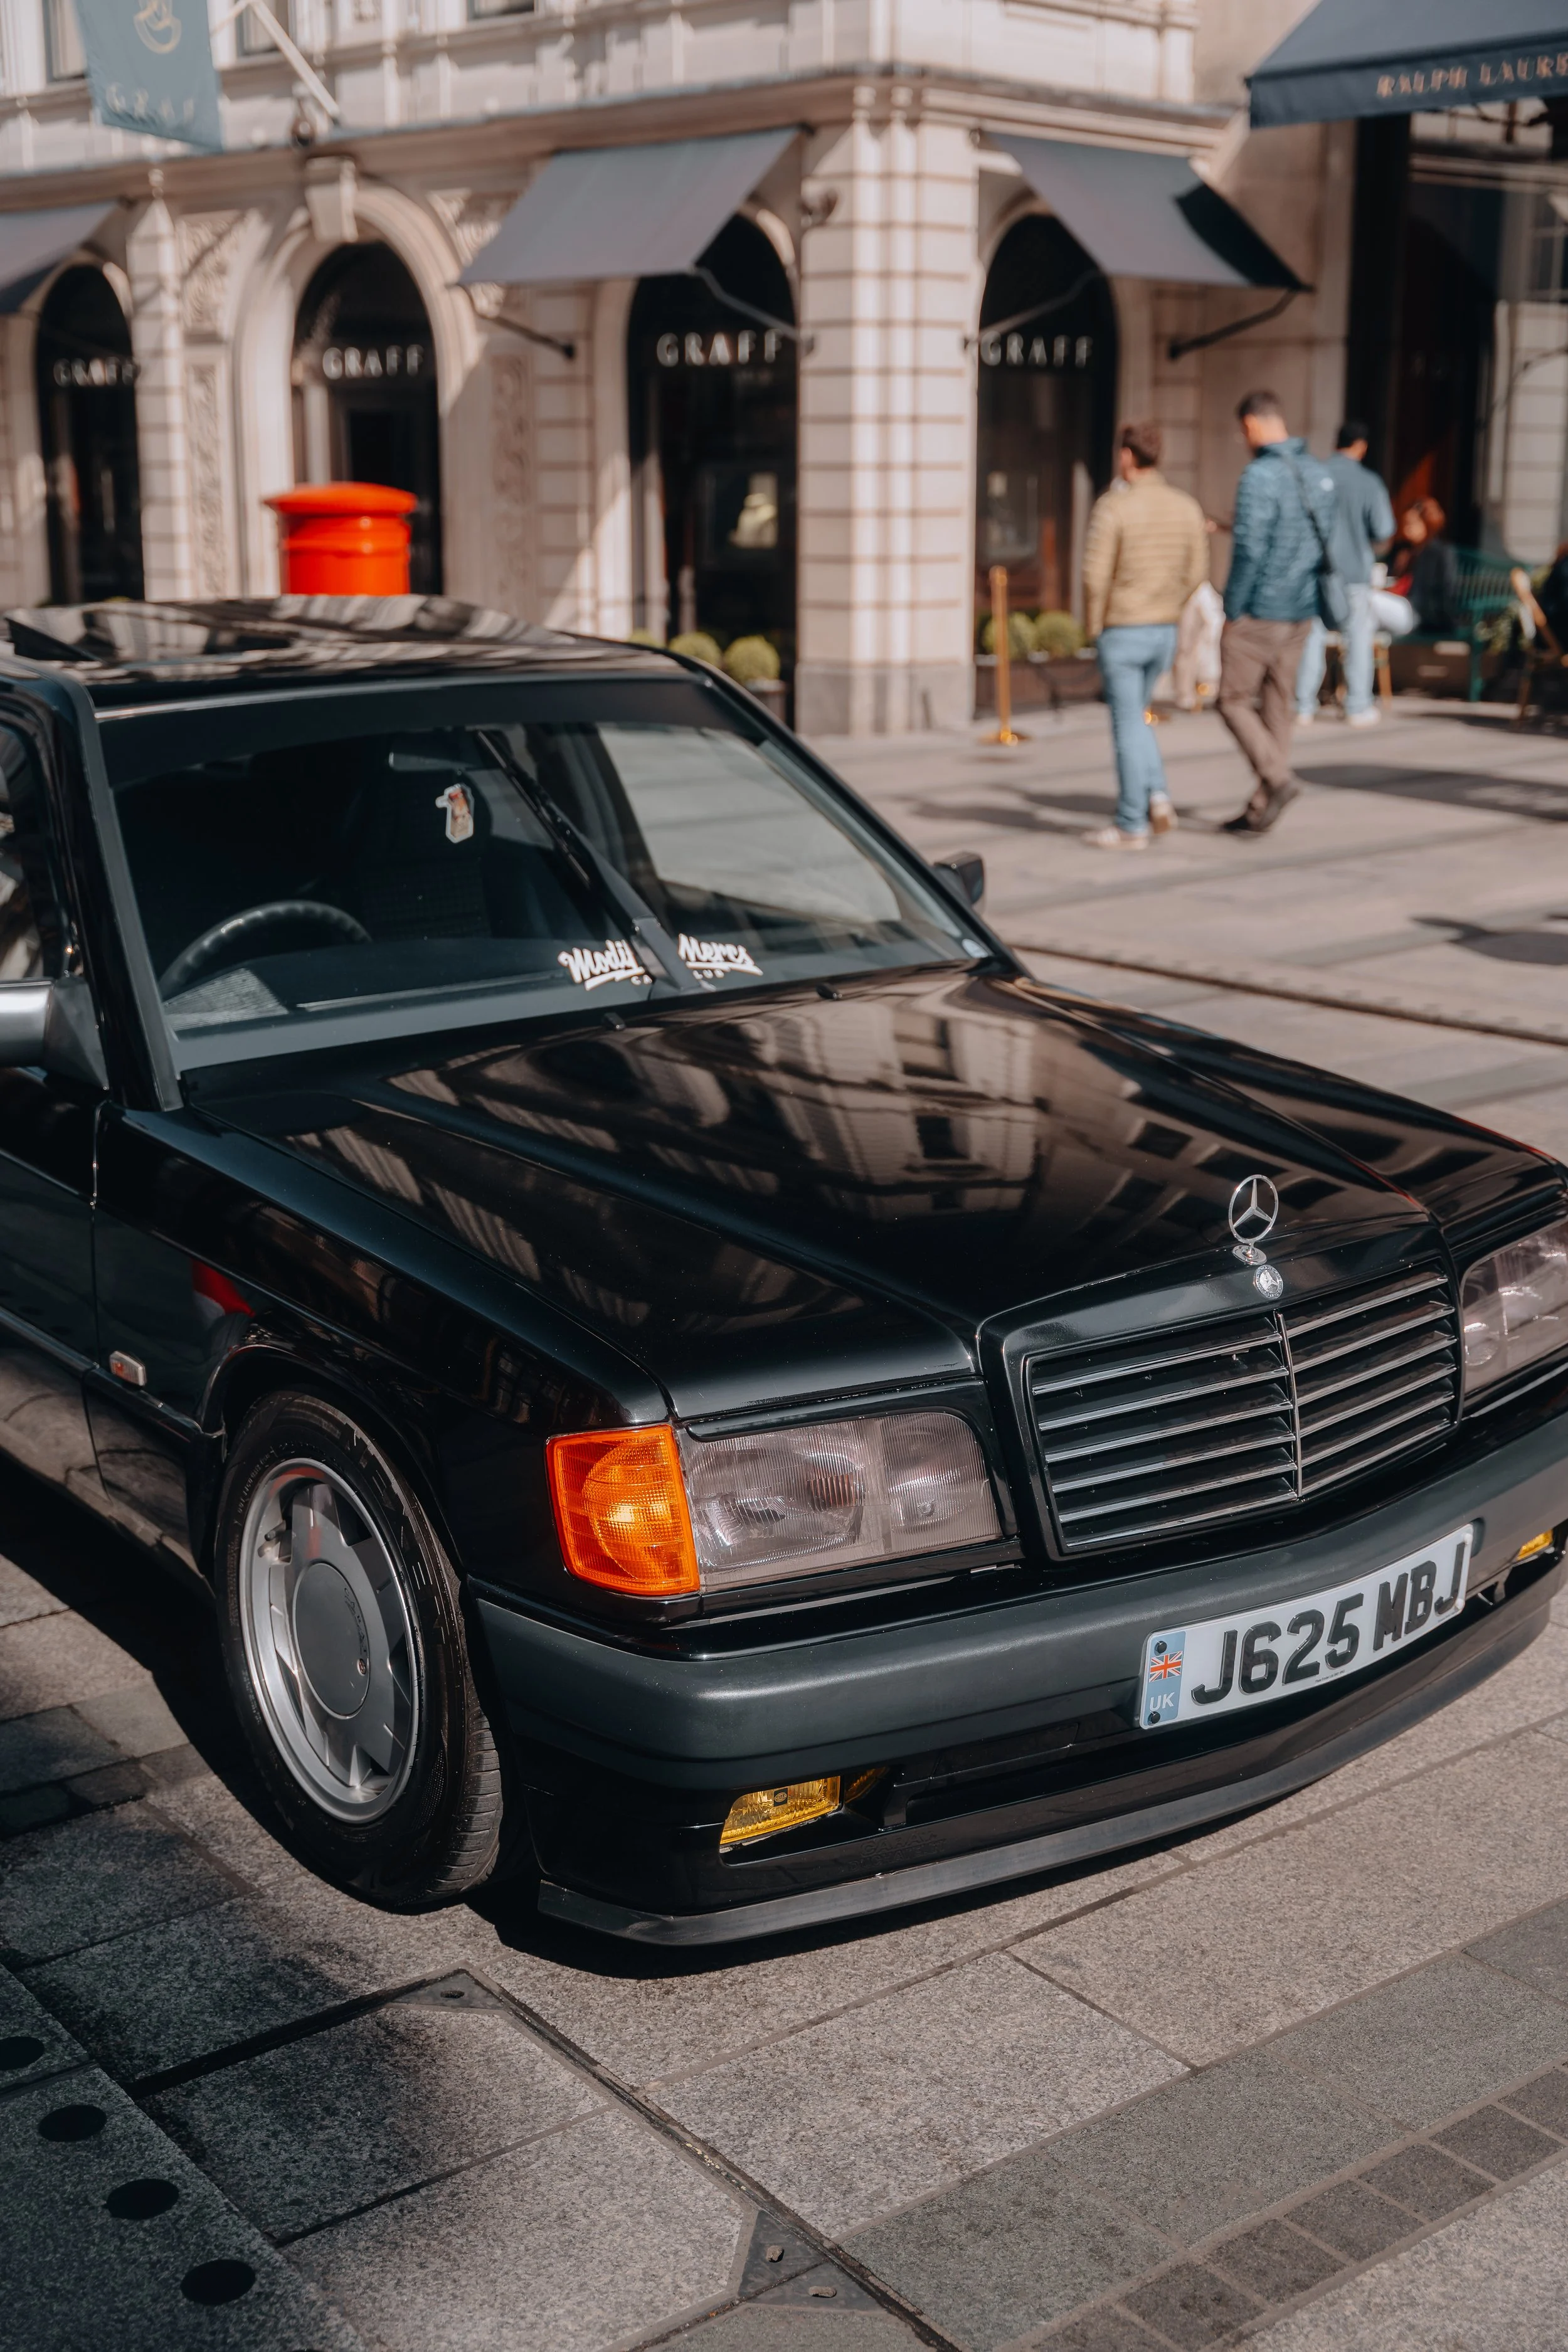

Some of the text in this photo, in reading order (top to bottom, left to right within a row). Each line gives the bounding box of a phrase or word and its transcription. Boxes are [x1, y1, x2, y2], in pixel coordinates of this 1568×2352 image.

[1376, 66, 1468, 98] RALPH
[323, 346, 424, 379] GRAFF
[657, 329, 782, 366] GRAFF
[980, 332, 1093, 367] GRAFF
[678, 933, 755, 966] Mercs
[1192, 1542, 1465, 1705] J625 MBJ
[1150, 1692, 1175, 1712] UK
